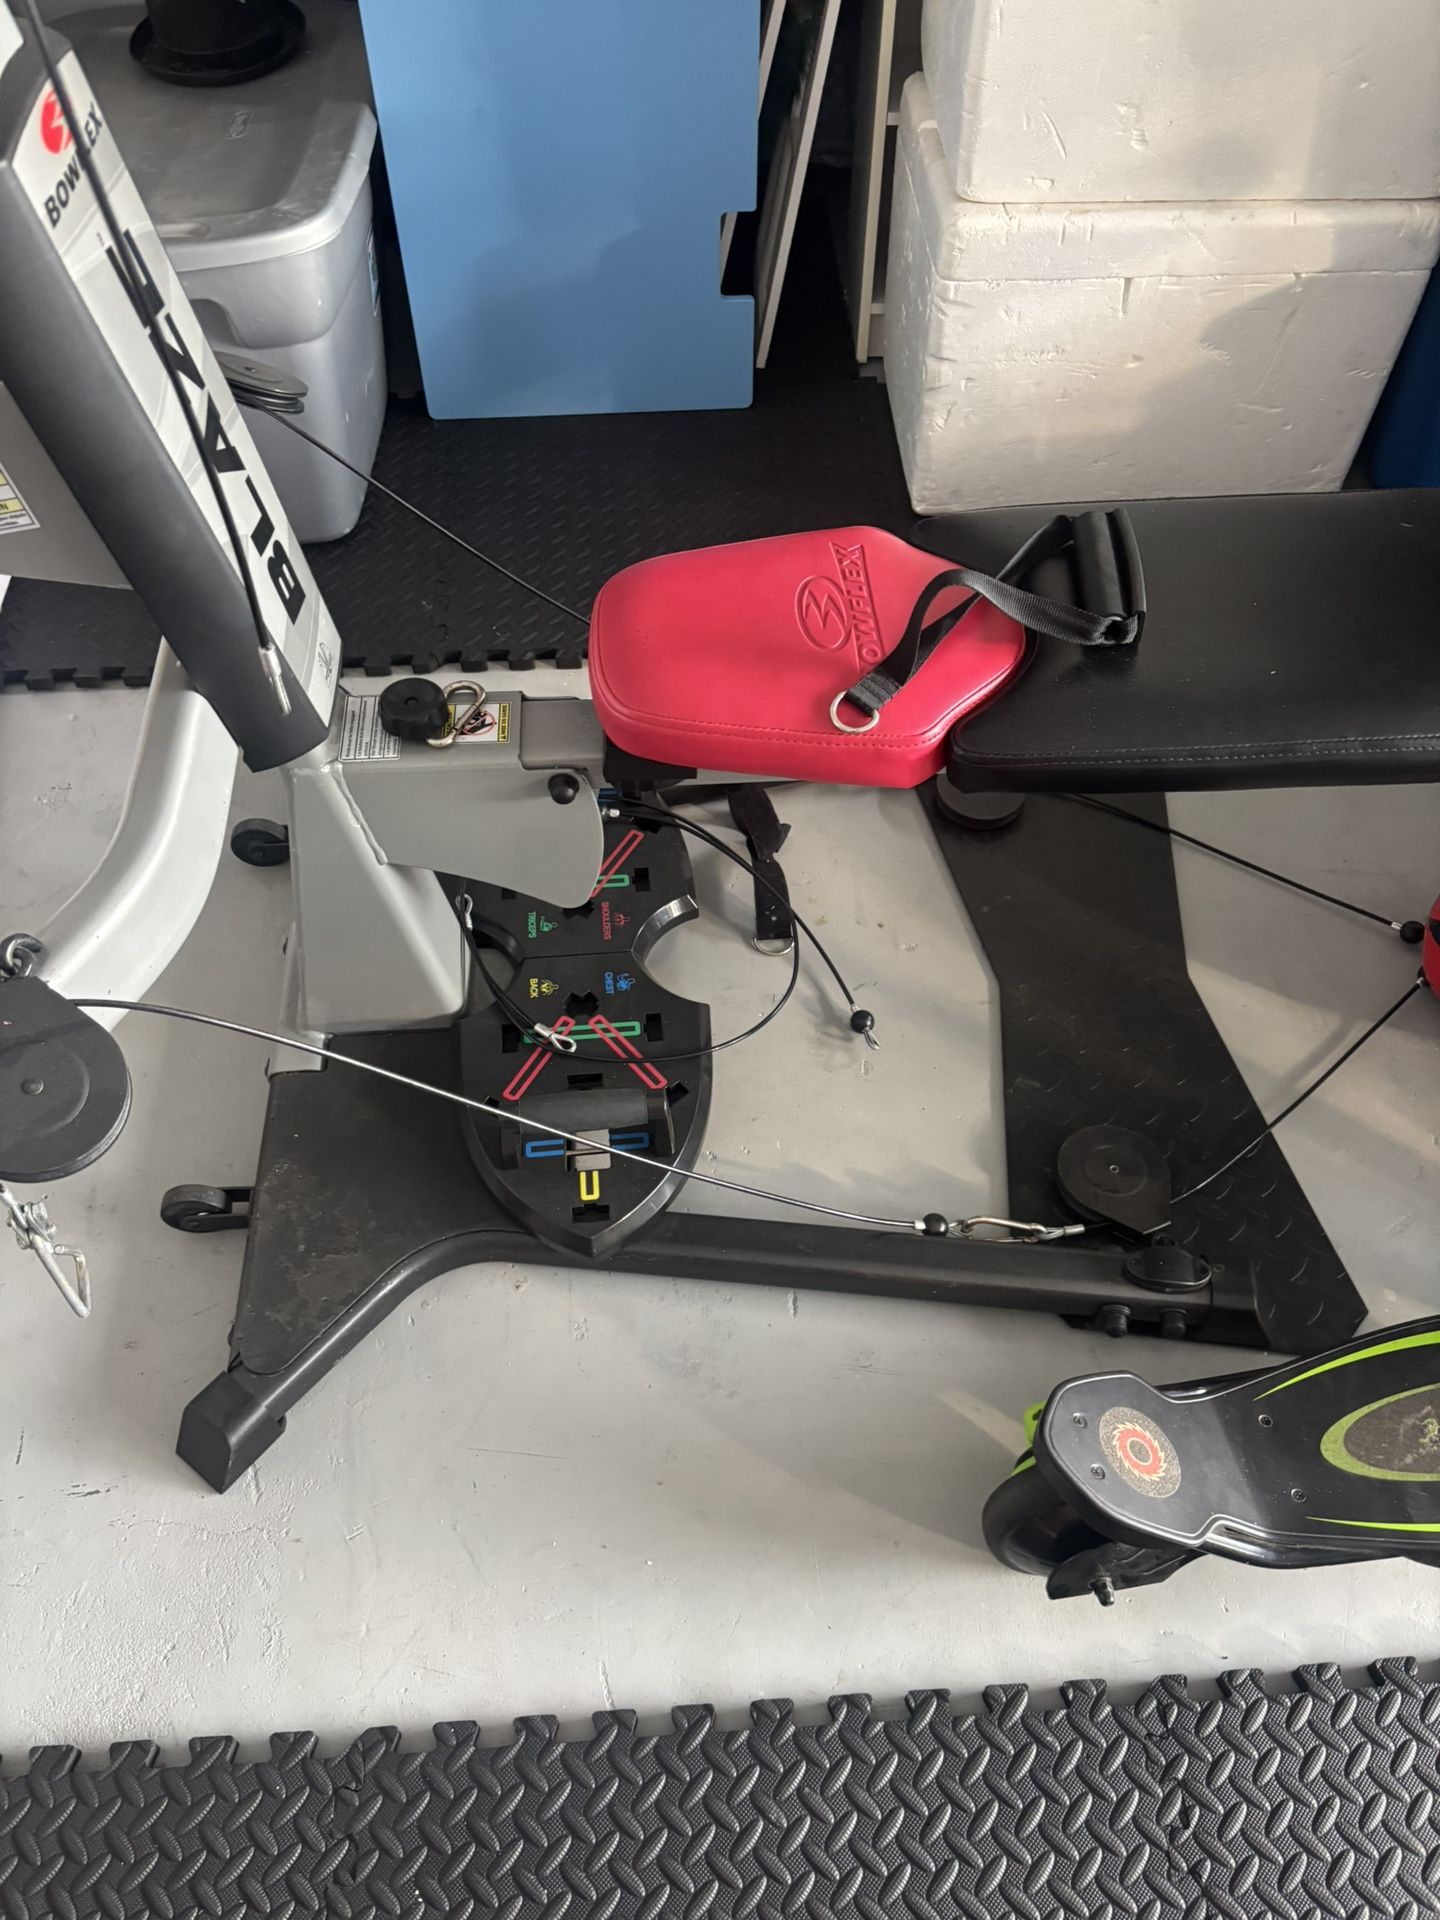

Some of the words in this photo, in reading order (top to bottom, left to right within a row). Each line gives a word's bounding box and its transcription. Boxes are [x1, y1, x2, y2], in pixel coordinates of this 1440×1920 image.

[44, 102, 102, 229] BOWEX
[105, 228, 306, 627] BLAZE
[834, 543, 885, 665] OWFLEX
[528, 911, 537, 939] TRICEPS
[601, 901, 612, 940] SHOULDERS
[529, 978, 538, 999] BACK
[604, 971, 614, 995] CHEST
